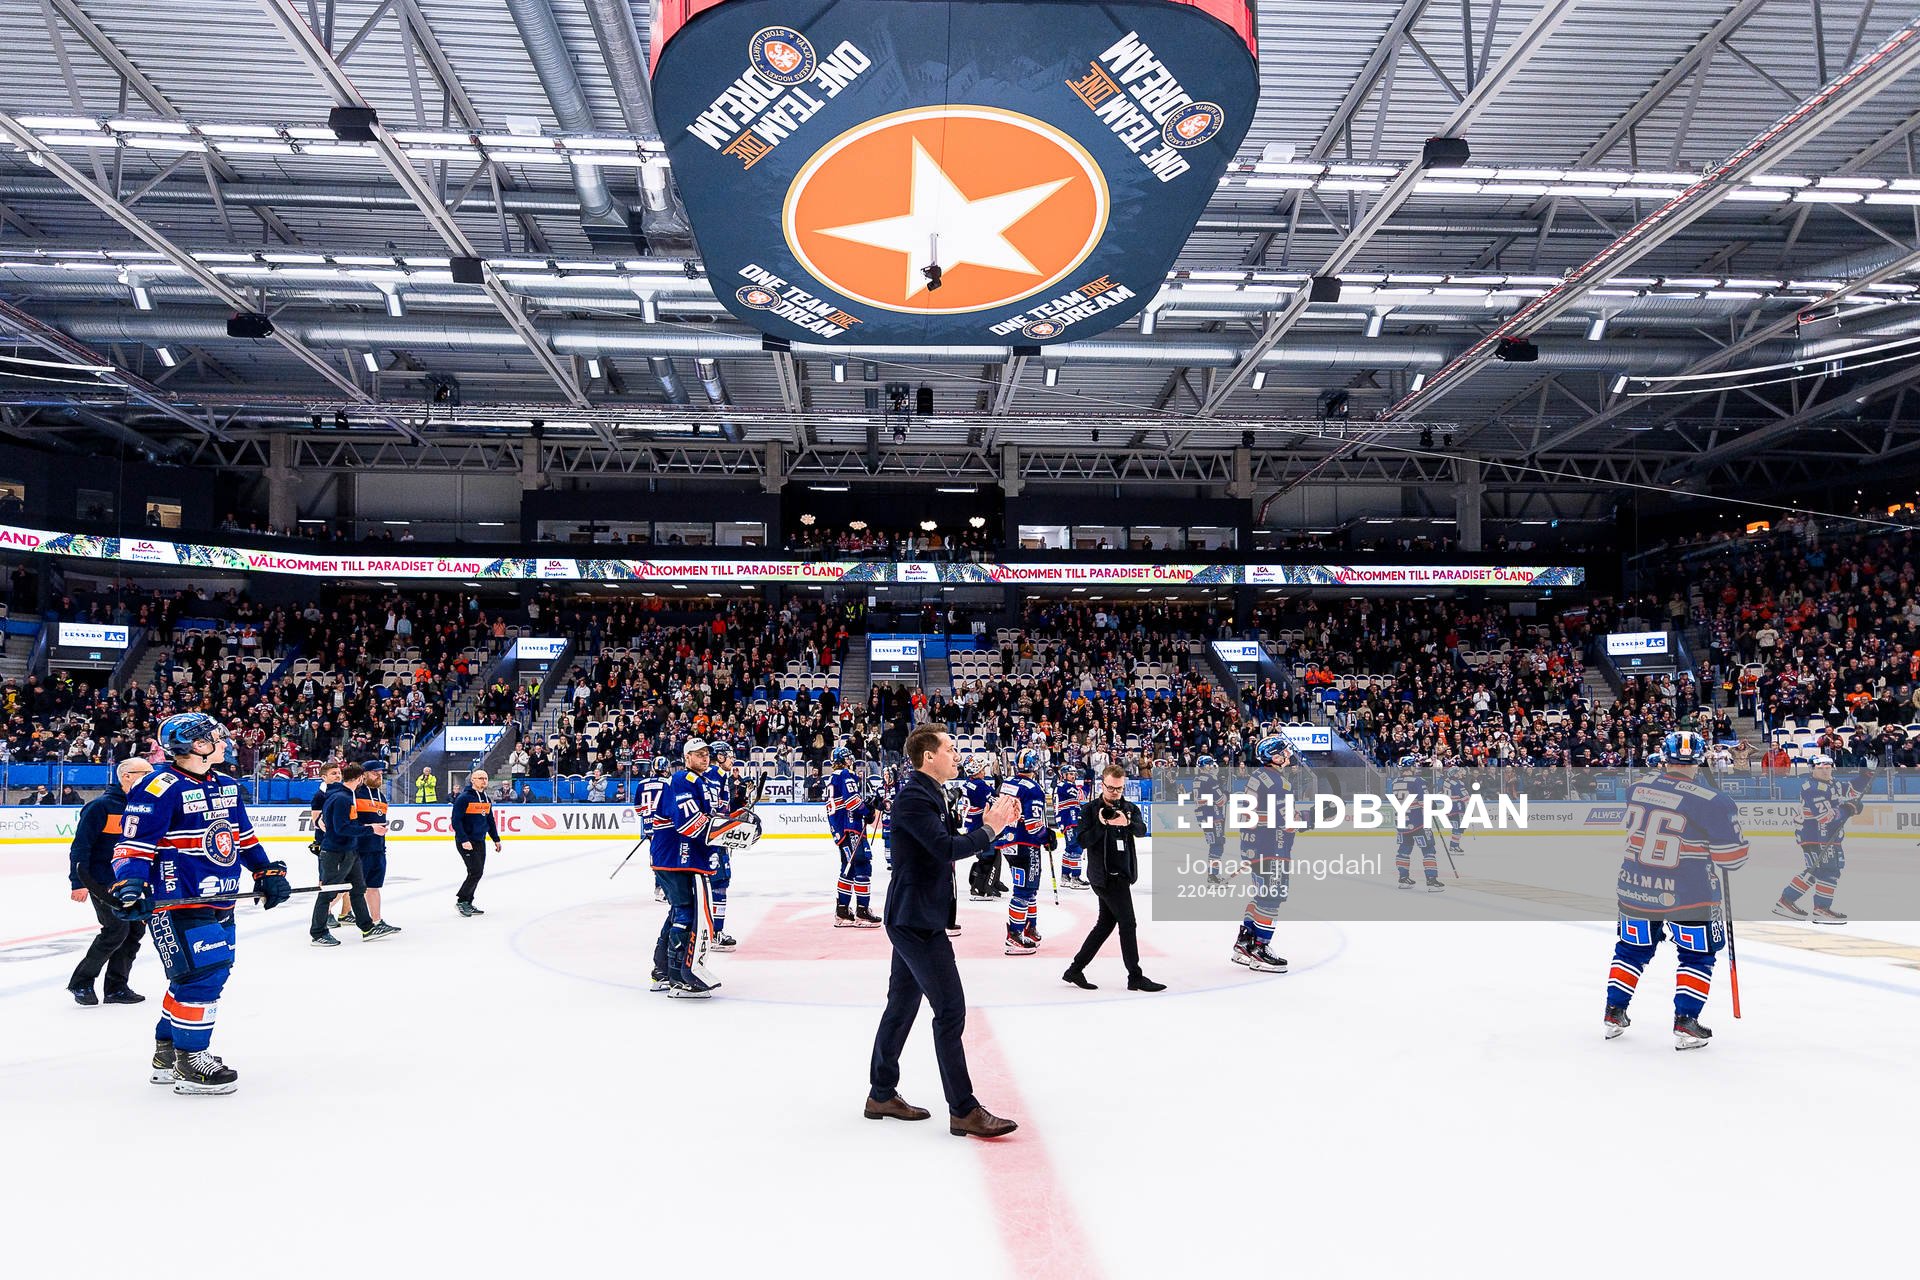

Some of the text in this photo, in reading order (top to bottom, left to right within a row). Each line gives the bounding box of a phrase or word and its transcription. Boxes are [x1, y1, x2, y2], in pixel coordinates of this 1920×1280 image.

[1099, 31, 1193, 125] DREAM
[686, 66, 785, 150] DREAM
[727, 40, 872, 166] ONE TEAM ONE
[1071, 66, 1191, 183] ONE TEAM ONE
[738, 263, 788, 291] ONE
[781, 286, 838, 317] TEAM
[826, 311, 858, 329] ONE
[989, 314, 1030, 336] ONE
[1026, 290, 1087, 319] TEAM
[1080, 276, 1116, 297] ONE
[1050, 284, 1137, 327] DREAM
[770, 299, 846, 338] DREAM
[138, 541, 154, 549] ICA
[248, 554, 480, 574] VÄLKOMMEN TILL PARADISET ÖLAND
[633, 562, 844, 577] VÄLKOMMEN TILL PARADISET ÖLAND
[990, 565, 1194, 580] VÄLKOMMEN TILL PARADISET ÖLAND
[1335, 567, 1534, 582] VÄLKOMMEN TILL PARADISET ÖLAND
[678, 799, 699, 818] 70
[1556, 813, 1573, 822] syd
[1591, 811, 1624, 819] ALWEX
[123, 815, 140, 838] 6
[416, 811, 520, 833] Scic
[563, 812, 619, 830] VISMA
[164, 860, 179, 892] nivka
[253, 869, 287, 880] CCM
[159, 910, 179, 954] NORDIC
